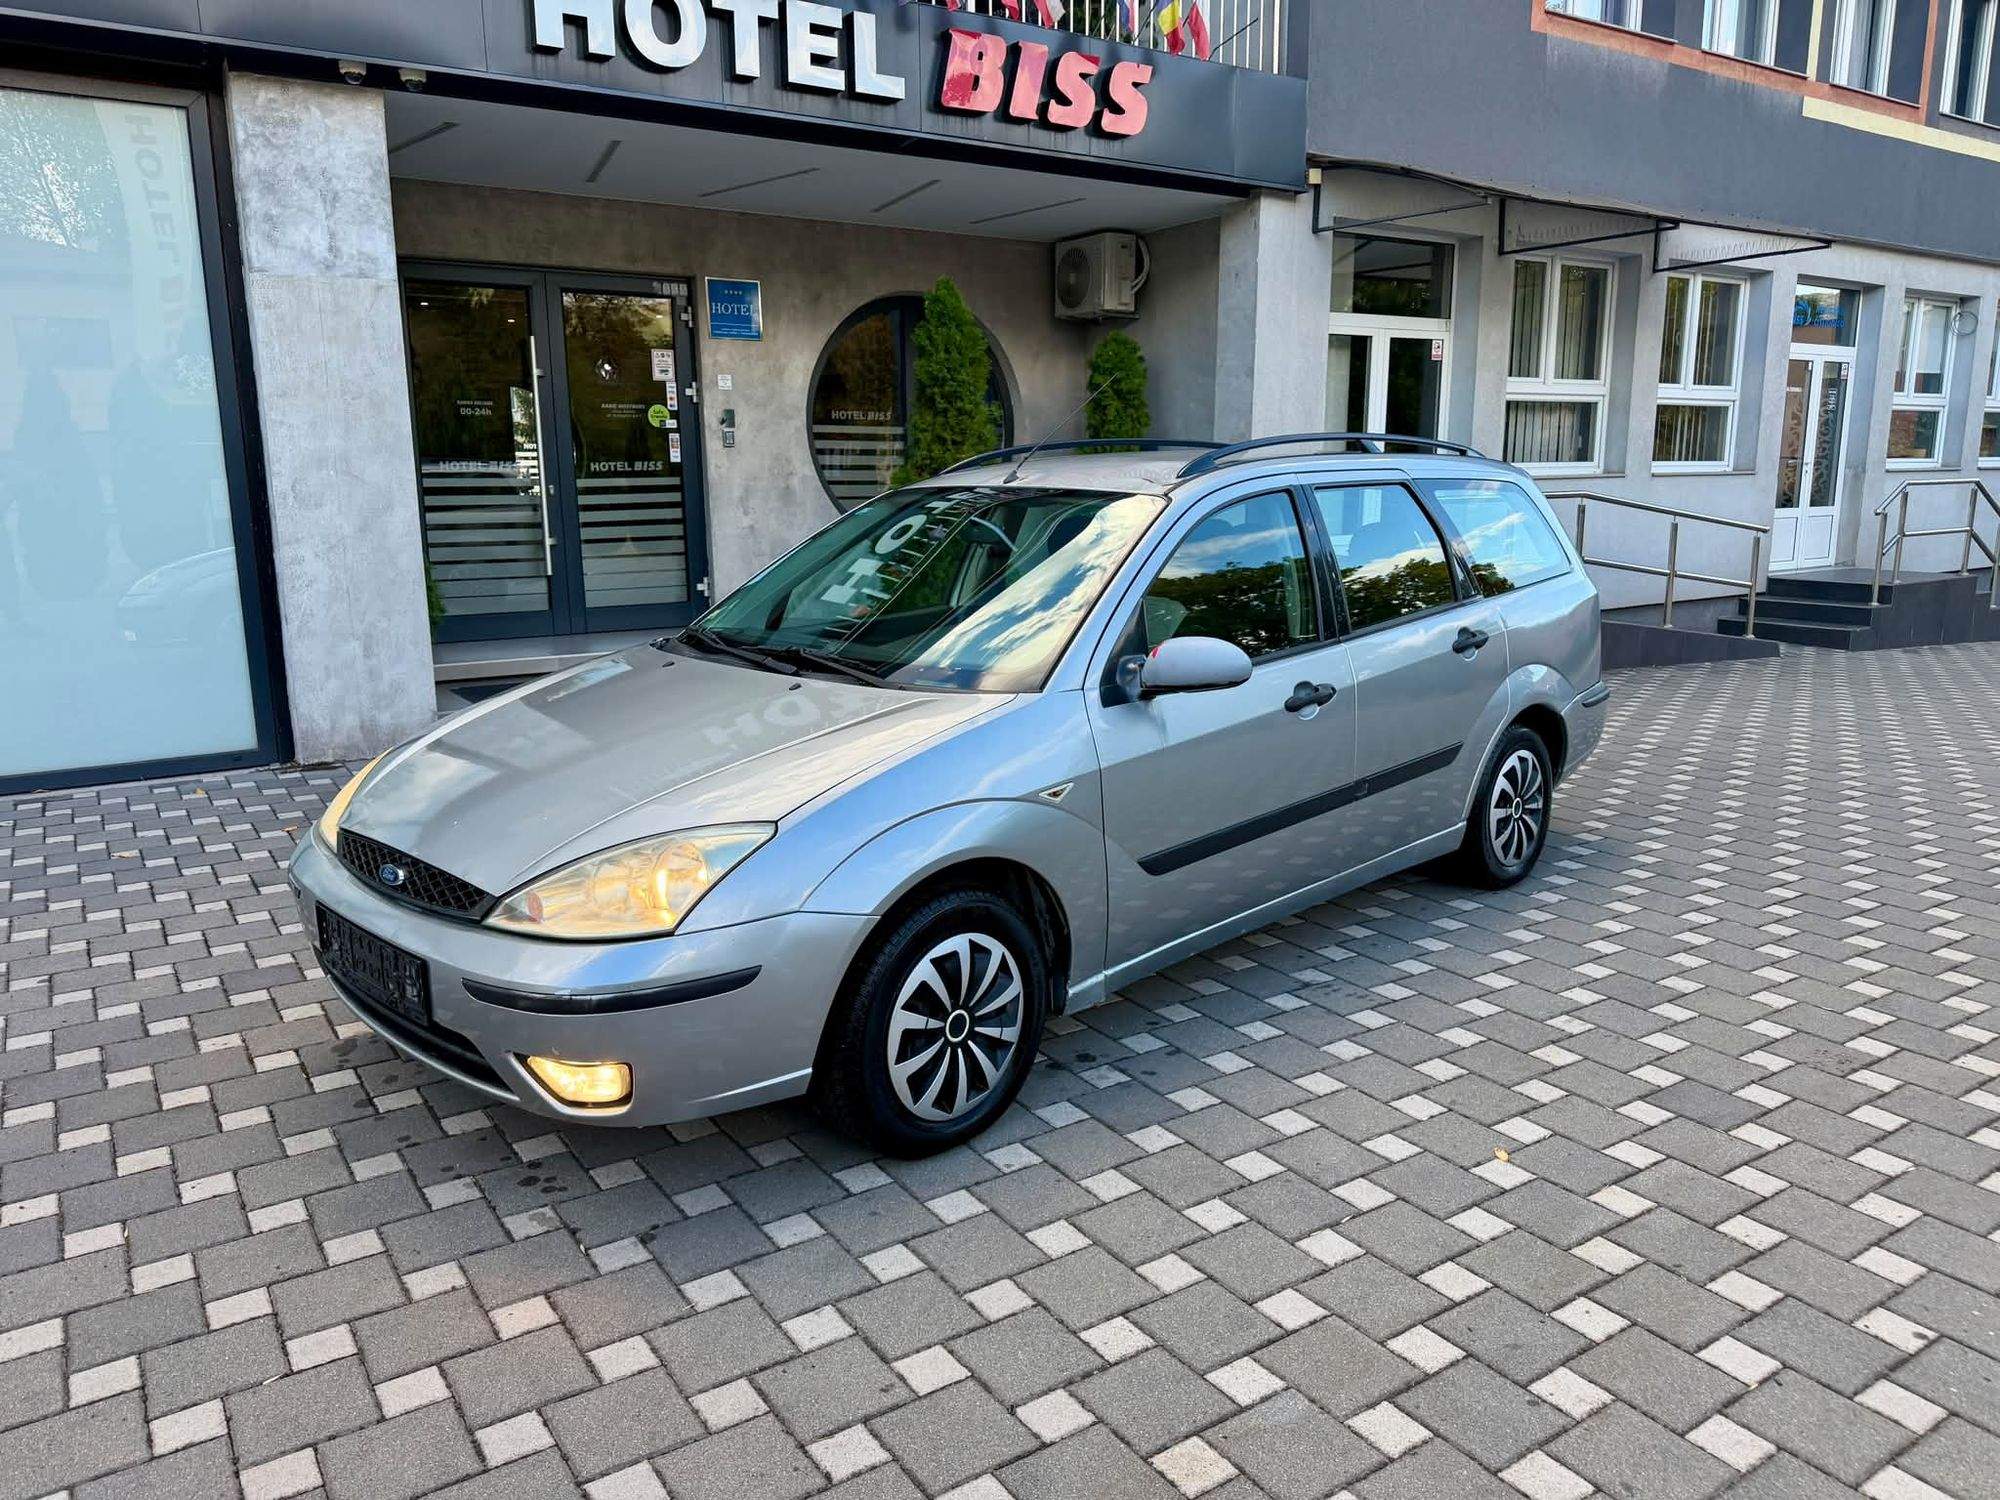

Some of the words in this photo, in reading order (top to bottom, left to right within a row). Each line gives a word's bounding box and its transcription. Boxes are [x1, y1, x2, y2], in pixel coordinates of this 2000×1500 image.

[532, 0, 906, 101] HOTEL
[940, 28, 1153, 136] BISS
[711, 301, 761, 318] HOTEL
[831, 410, 866, 421] HOTEL
[590, 461, 632, 472] HOTEL
[634, 461, 664, 472] BISS
